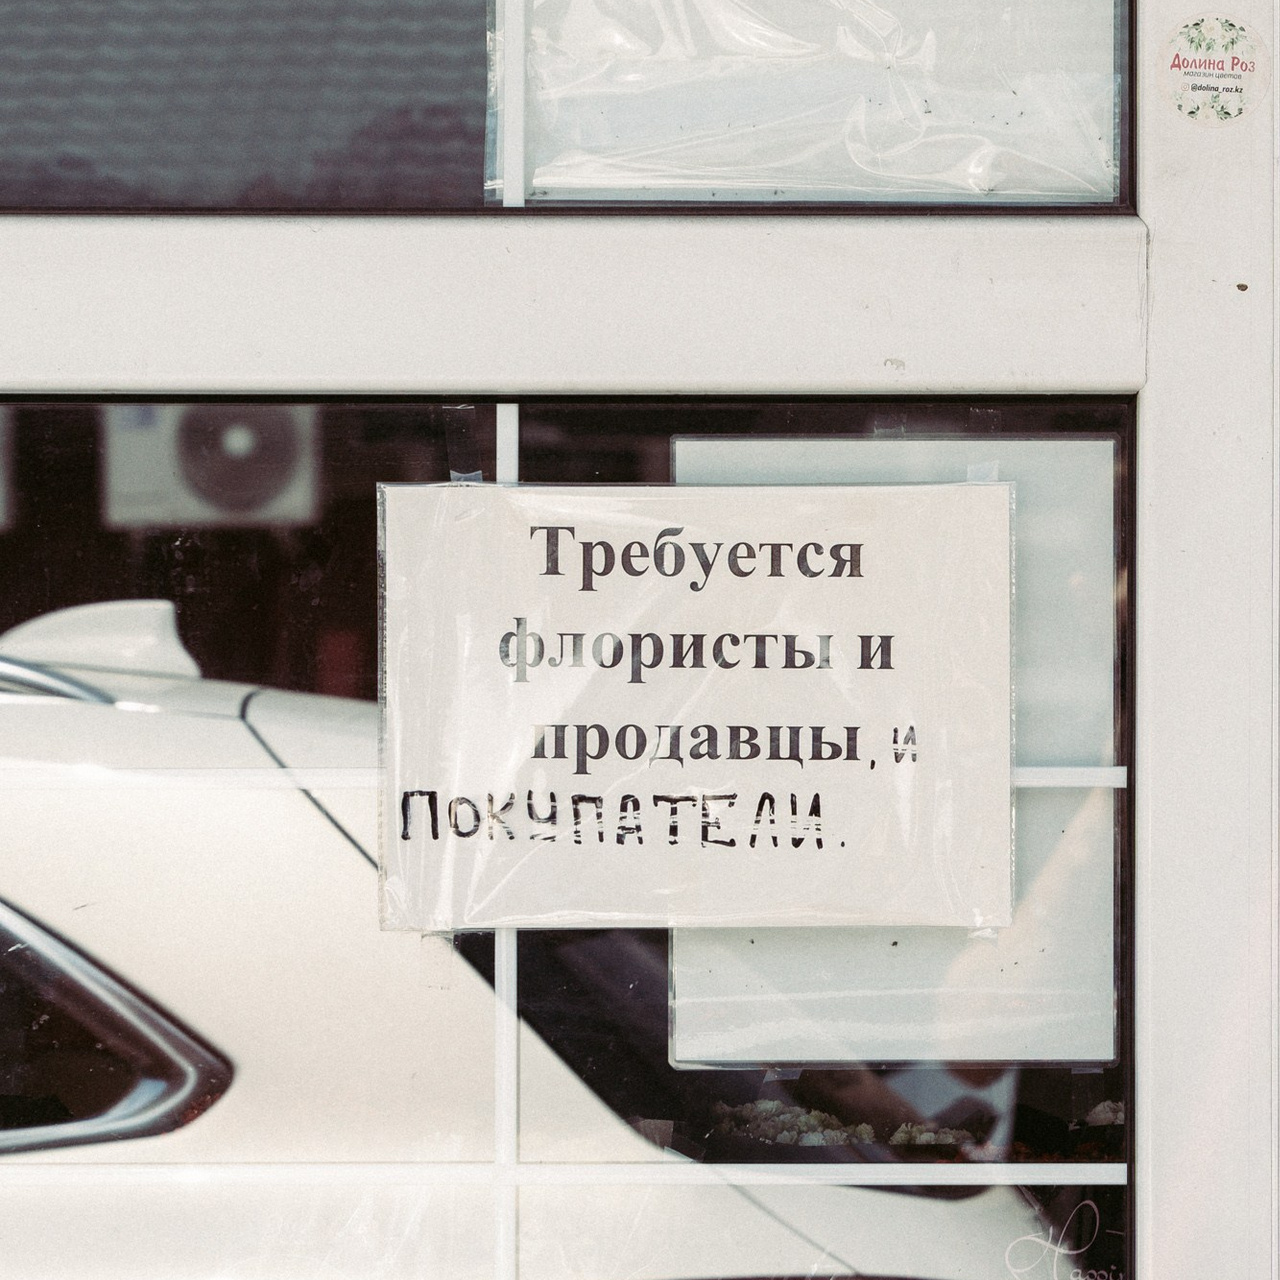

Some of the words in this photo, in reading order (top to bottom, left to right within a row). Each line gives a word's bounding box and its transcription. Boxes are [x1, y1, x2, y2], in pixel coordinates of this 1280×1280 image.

[1170, 52, 1225, 71] Долина
[1231, 56, 1256, 73] Роз
[1190, 83, 1244, 94] @dolina_roz.kz
[529, 526, 864, 592] Требуется
[499, 617, 833, 684] флористы
[856, 634, 895, 670] и
